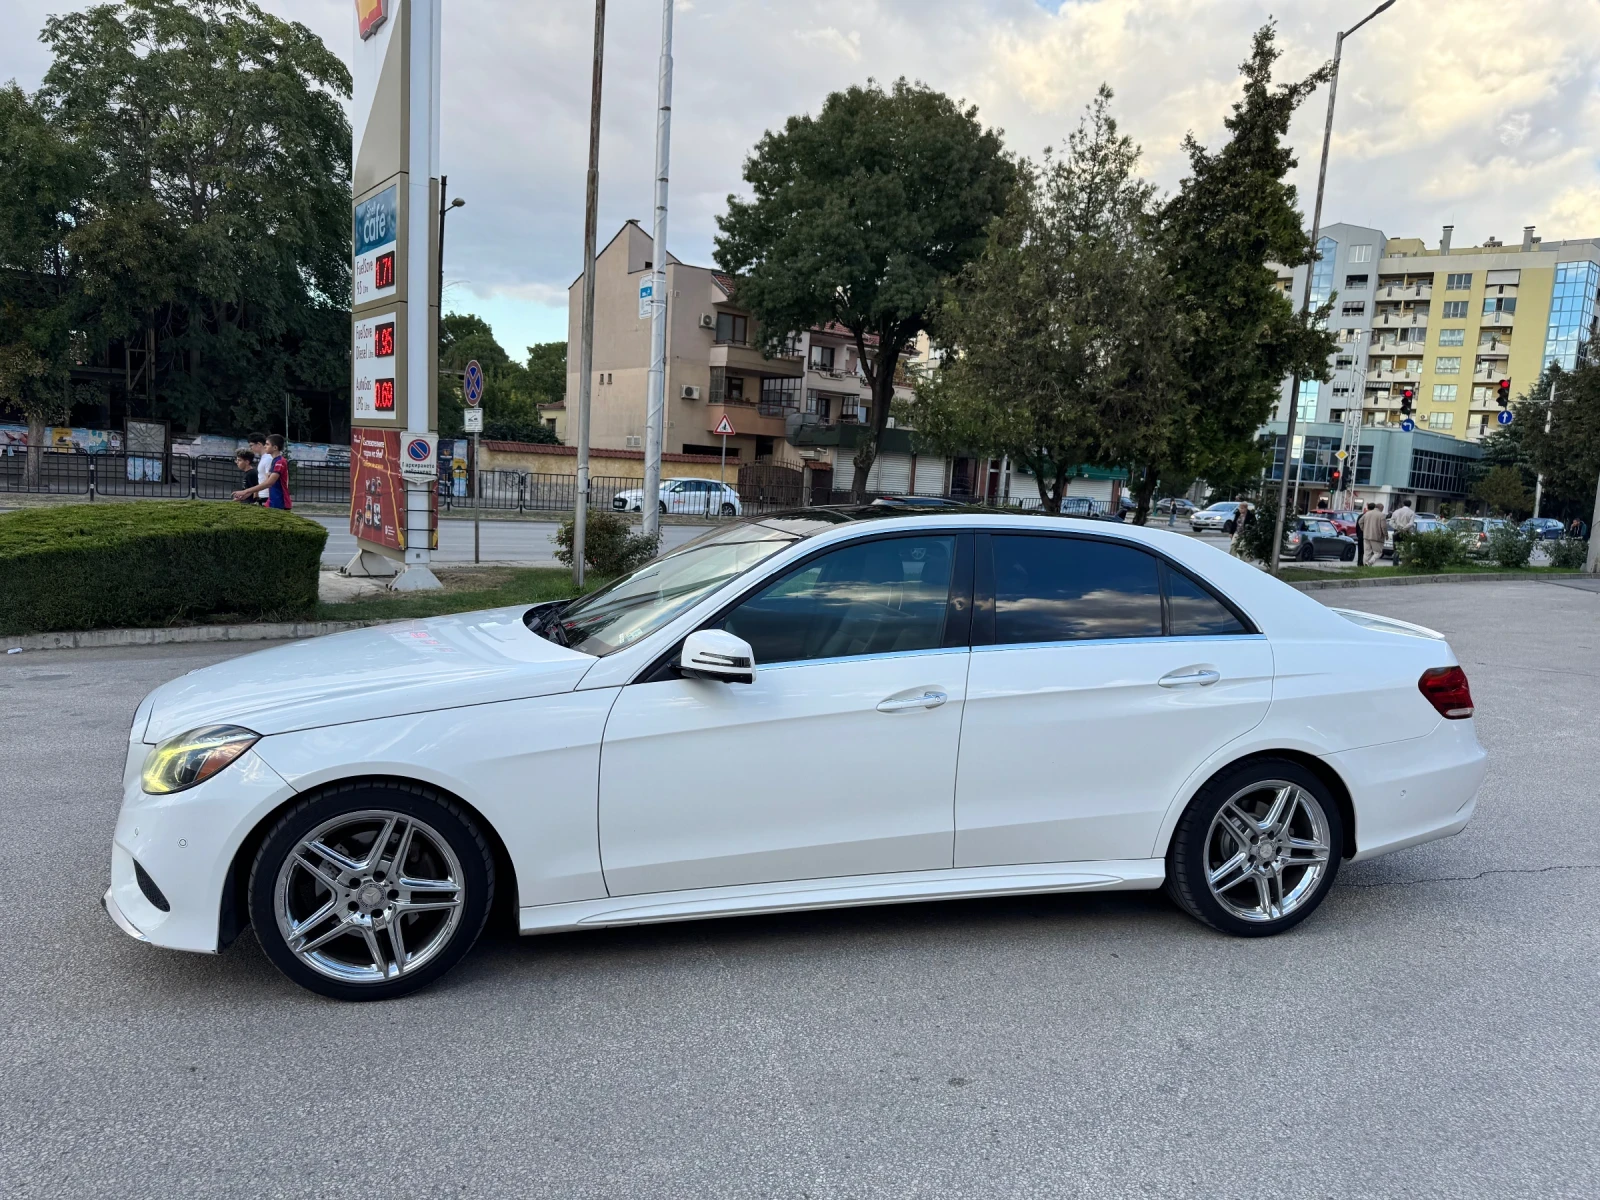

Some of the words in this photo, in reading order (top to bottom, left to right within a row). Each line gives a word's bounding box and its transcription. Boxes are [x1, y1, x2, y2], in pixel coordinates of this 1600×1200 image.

[363, 203, 386, 244] café
[356, 257, 374, 276] FuelSave
[375, 256, 392, 287] 1.71
[356, 280, 362, 295] 95
[356, 323, 373, 340] FuelSave
[374, 327, 393, 356] 1.95
[356, 343, 367, 360] Diesel
[355, 376, 372, 391] AutoGas
[355, 396, 364, 411] LPG
[374, 381, 393, 408] 0.69
